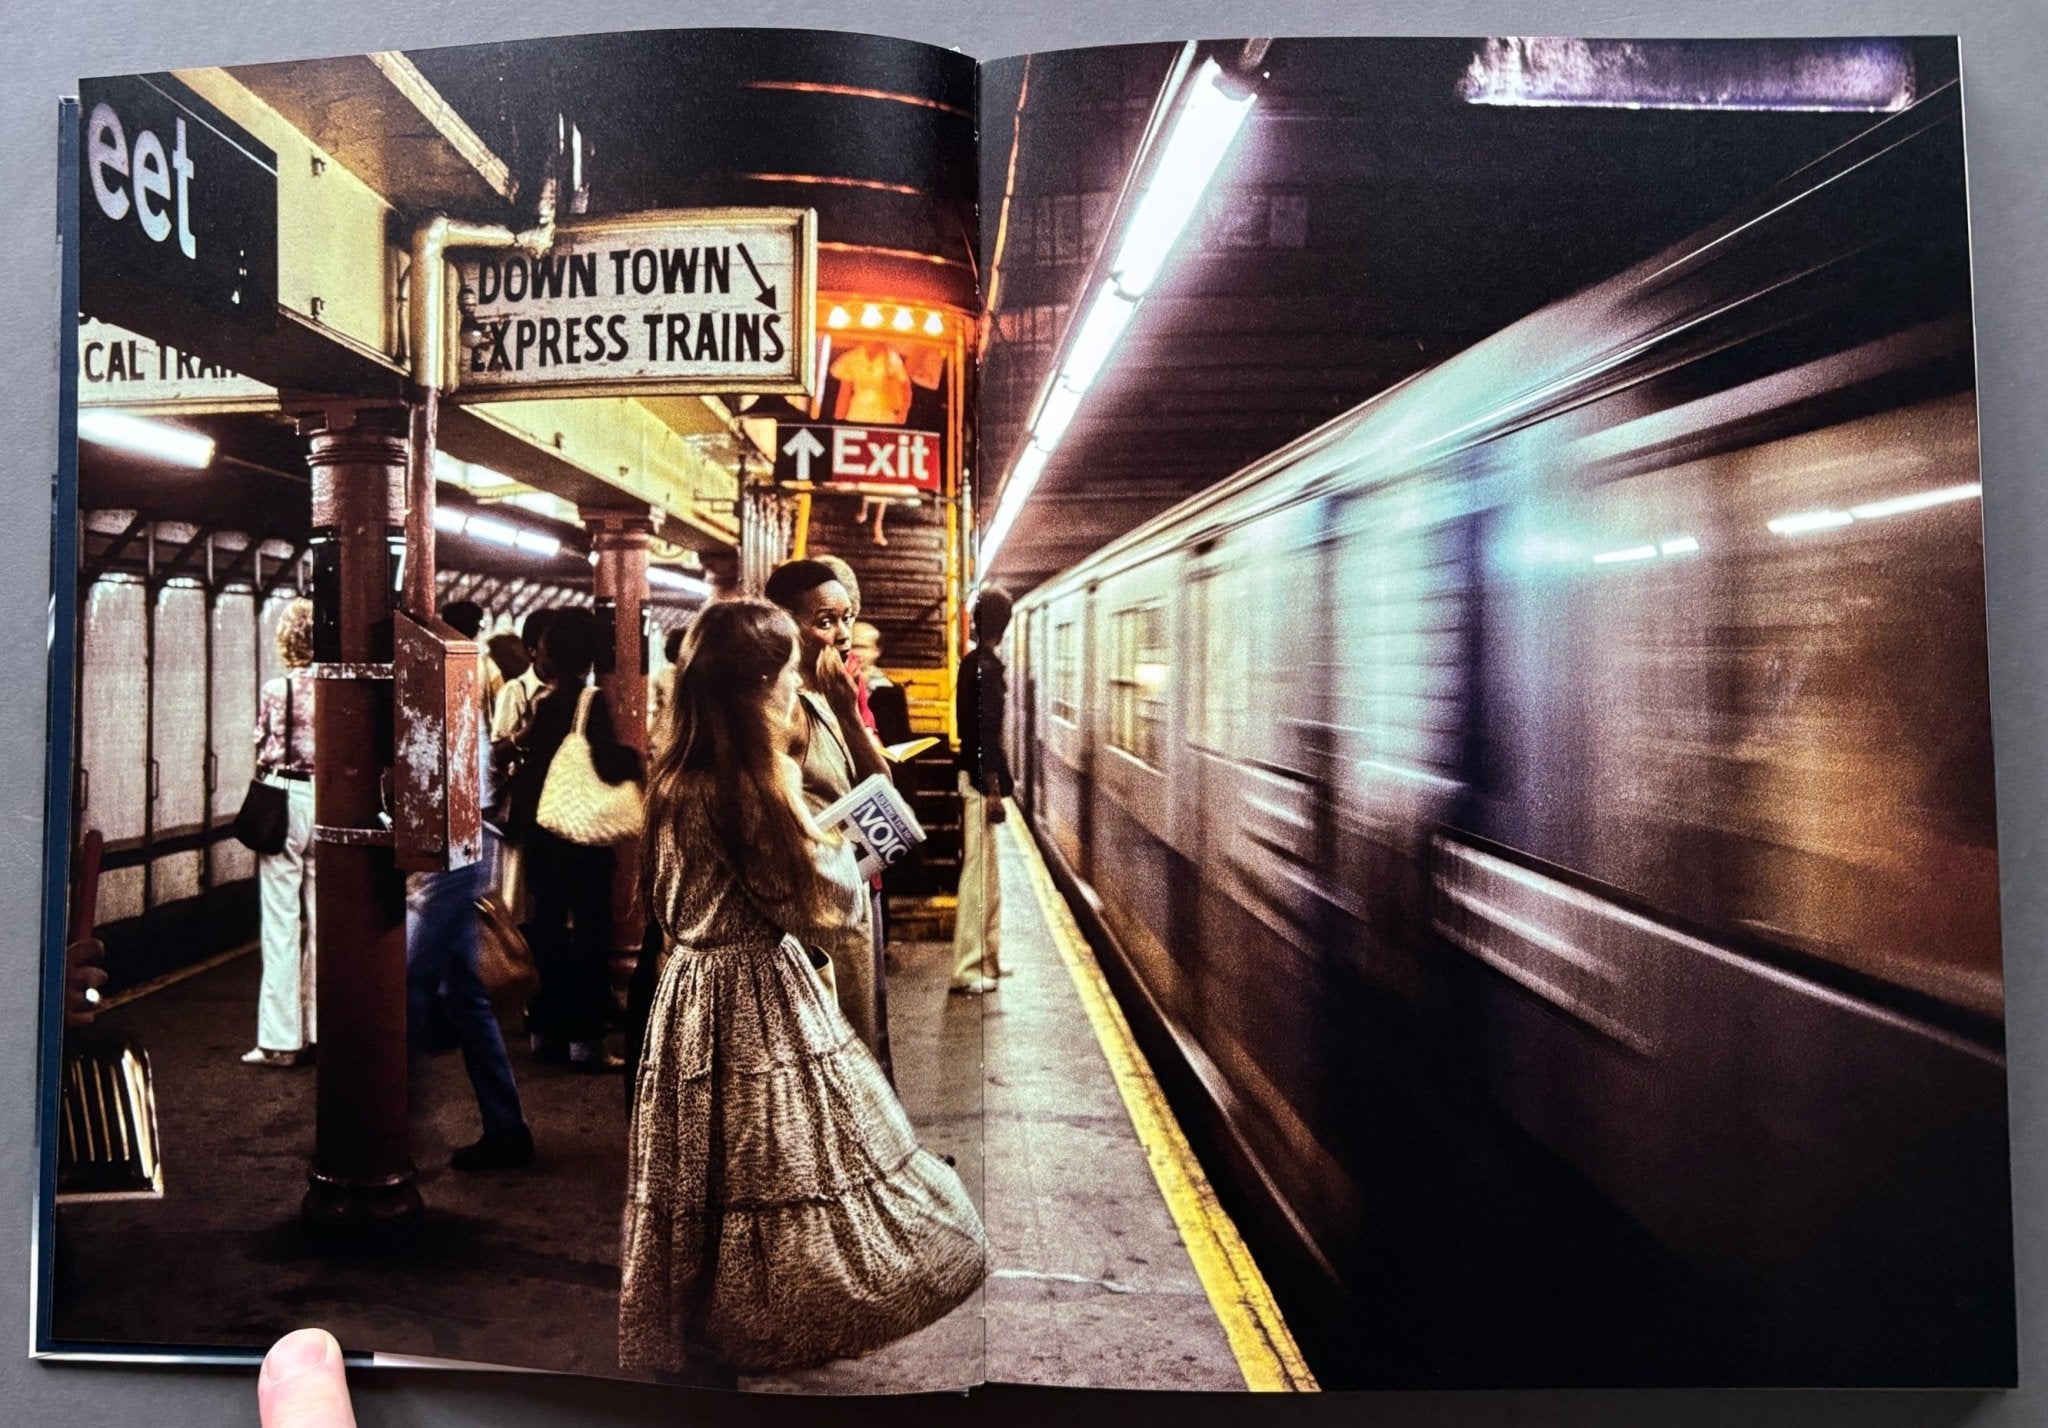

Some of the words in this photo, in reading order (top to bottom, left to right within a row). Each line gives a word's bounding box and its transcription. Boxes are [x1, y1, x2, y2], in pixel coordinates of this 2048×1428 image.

[88, 103, 197, 259] eet
[478, 252, 597, 305] DOWN
[609, 246, 730, 295] TOWN
[470, 314, 630, 372] EXPRESS
[643, 313, 785, 363] TRAINS
[833, 428, 929, 480] Exit
